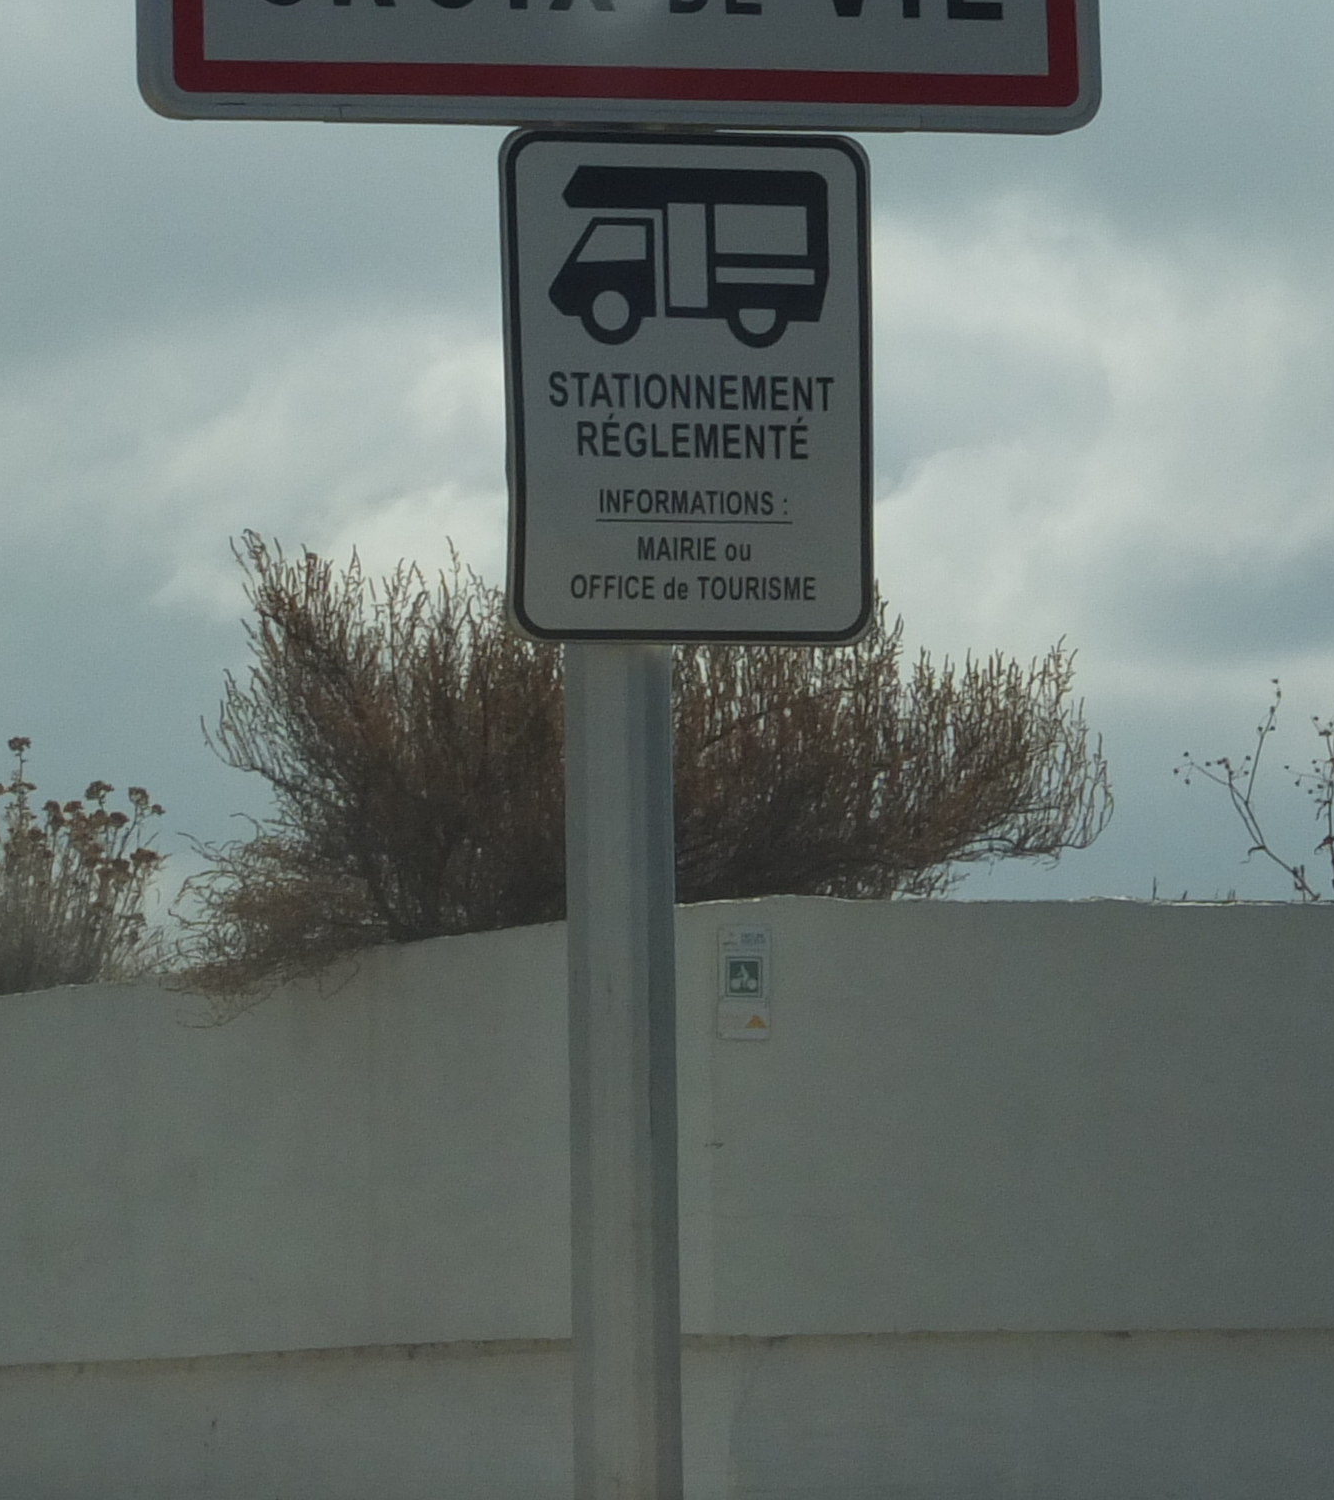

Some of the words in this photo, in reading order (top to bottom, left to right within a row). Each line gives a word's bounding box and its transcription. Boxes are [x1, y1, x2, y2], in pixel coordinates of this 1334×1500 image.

[548, 371, 835, 412] STATIONNEMENT
[576, 413, 809, 460] RÉGLEMENTÉ
[637, 536, 717, 562] MAIRIE
[724, 543, 752, 562] ou
[570, 574, 655, 600] OFFICE
[663, 576, 689, 601] de
[697, 575, 816, 601] TOURISME
